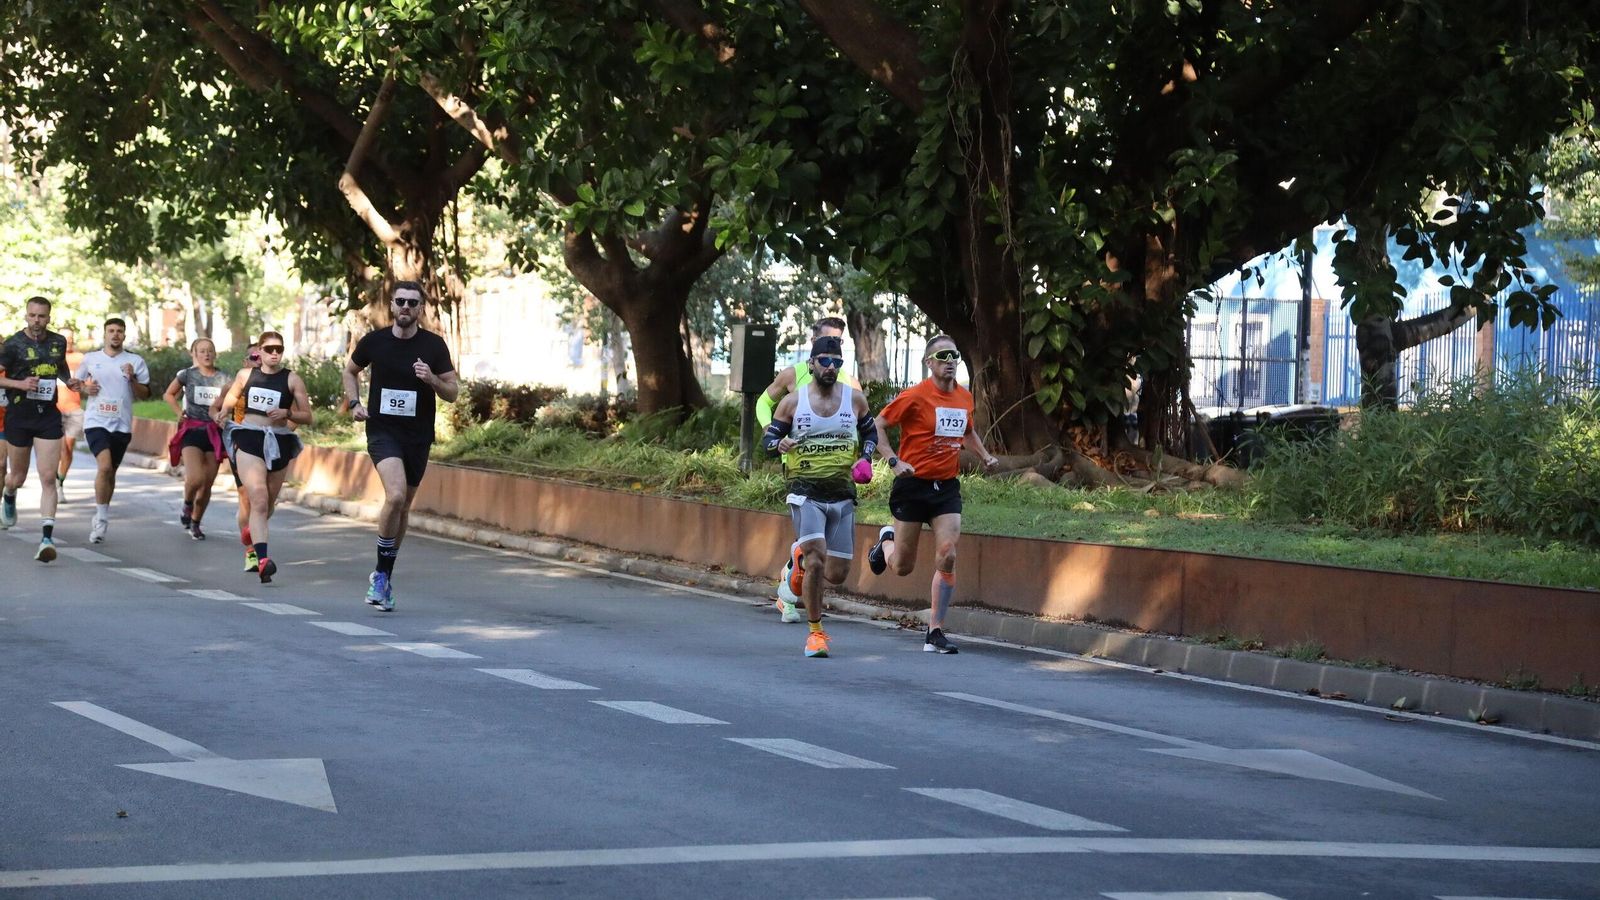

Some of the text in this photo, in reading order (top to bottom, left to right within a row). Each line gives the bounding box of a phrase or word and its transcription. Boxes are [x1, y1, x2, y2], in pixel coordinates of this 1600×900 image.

[253, 395, 273, 405] 972
[390, 399, 405, 408] 92
[100, 404, 117, 412] 586
[939, 418, 964, 428] 1737
